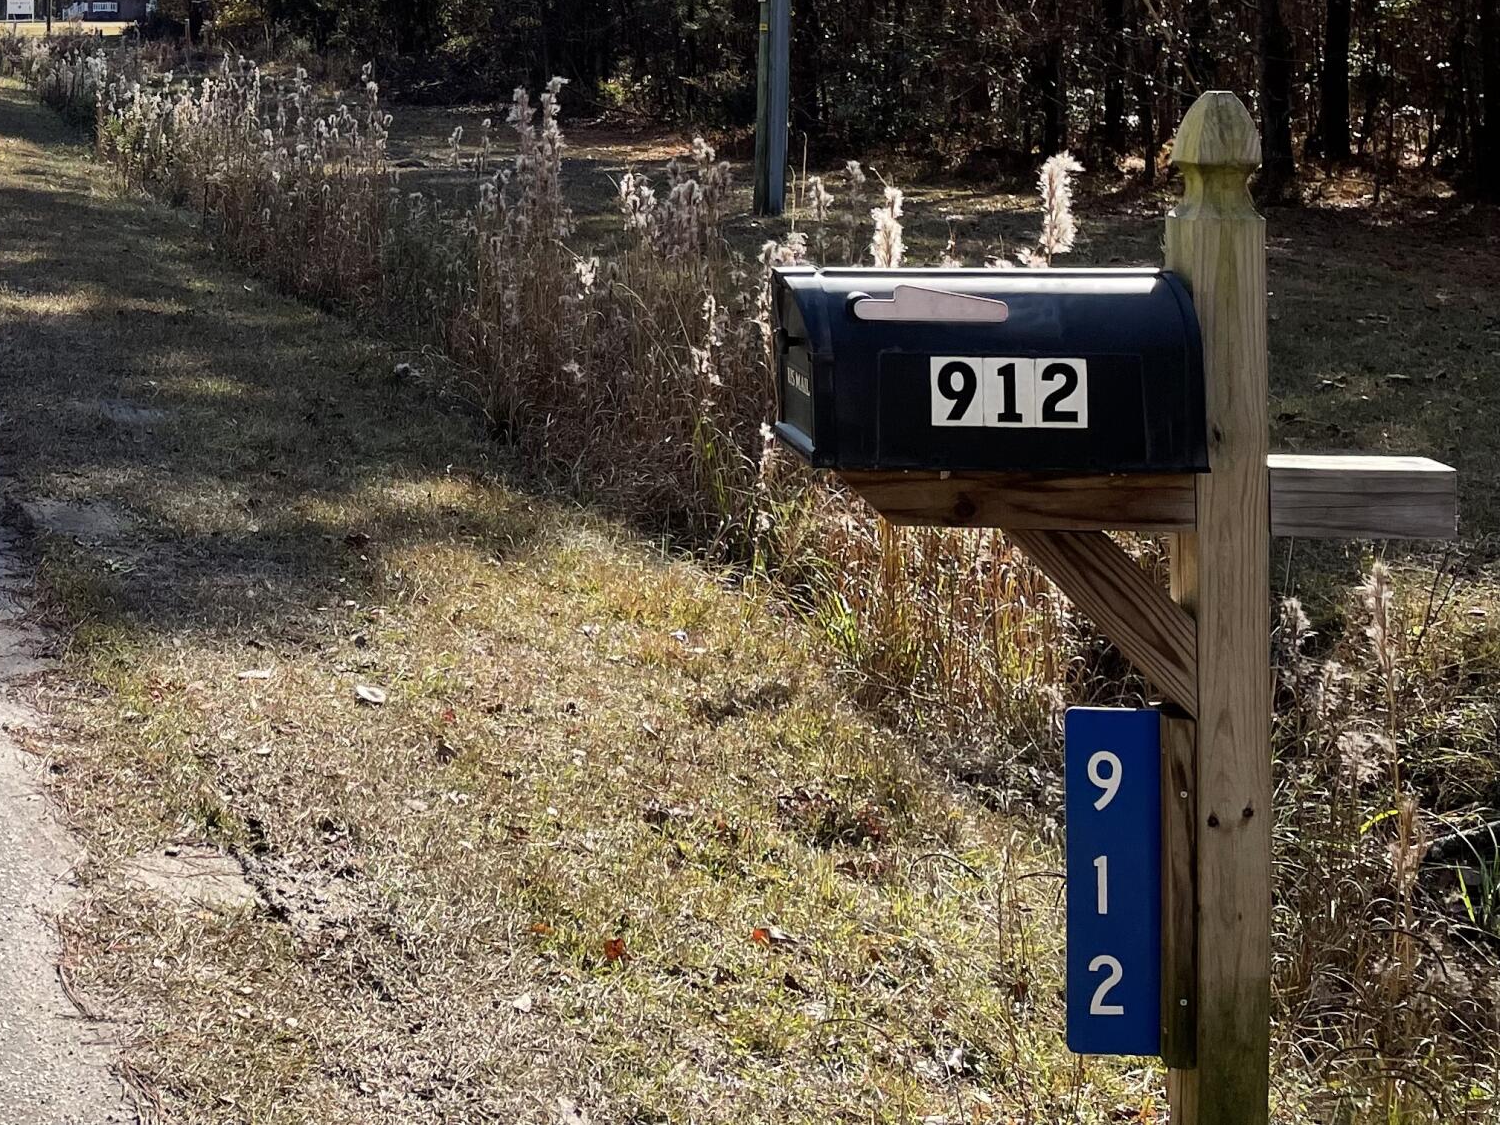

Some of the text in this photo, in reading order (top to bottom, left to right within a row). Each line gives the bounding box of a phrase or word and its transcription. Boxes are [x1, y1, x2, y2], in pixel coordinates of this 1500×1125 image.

[795, 371, 811, 396] MAIL
[937, 361, 1078, 423] 912
[1087, 751, 1124, 1015] 912
